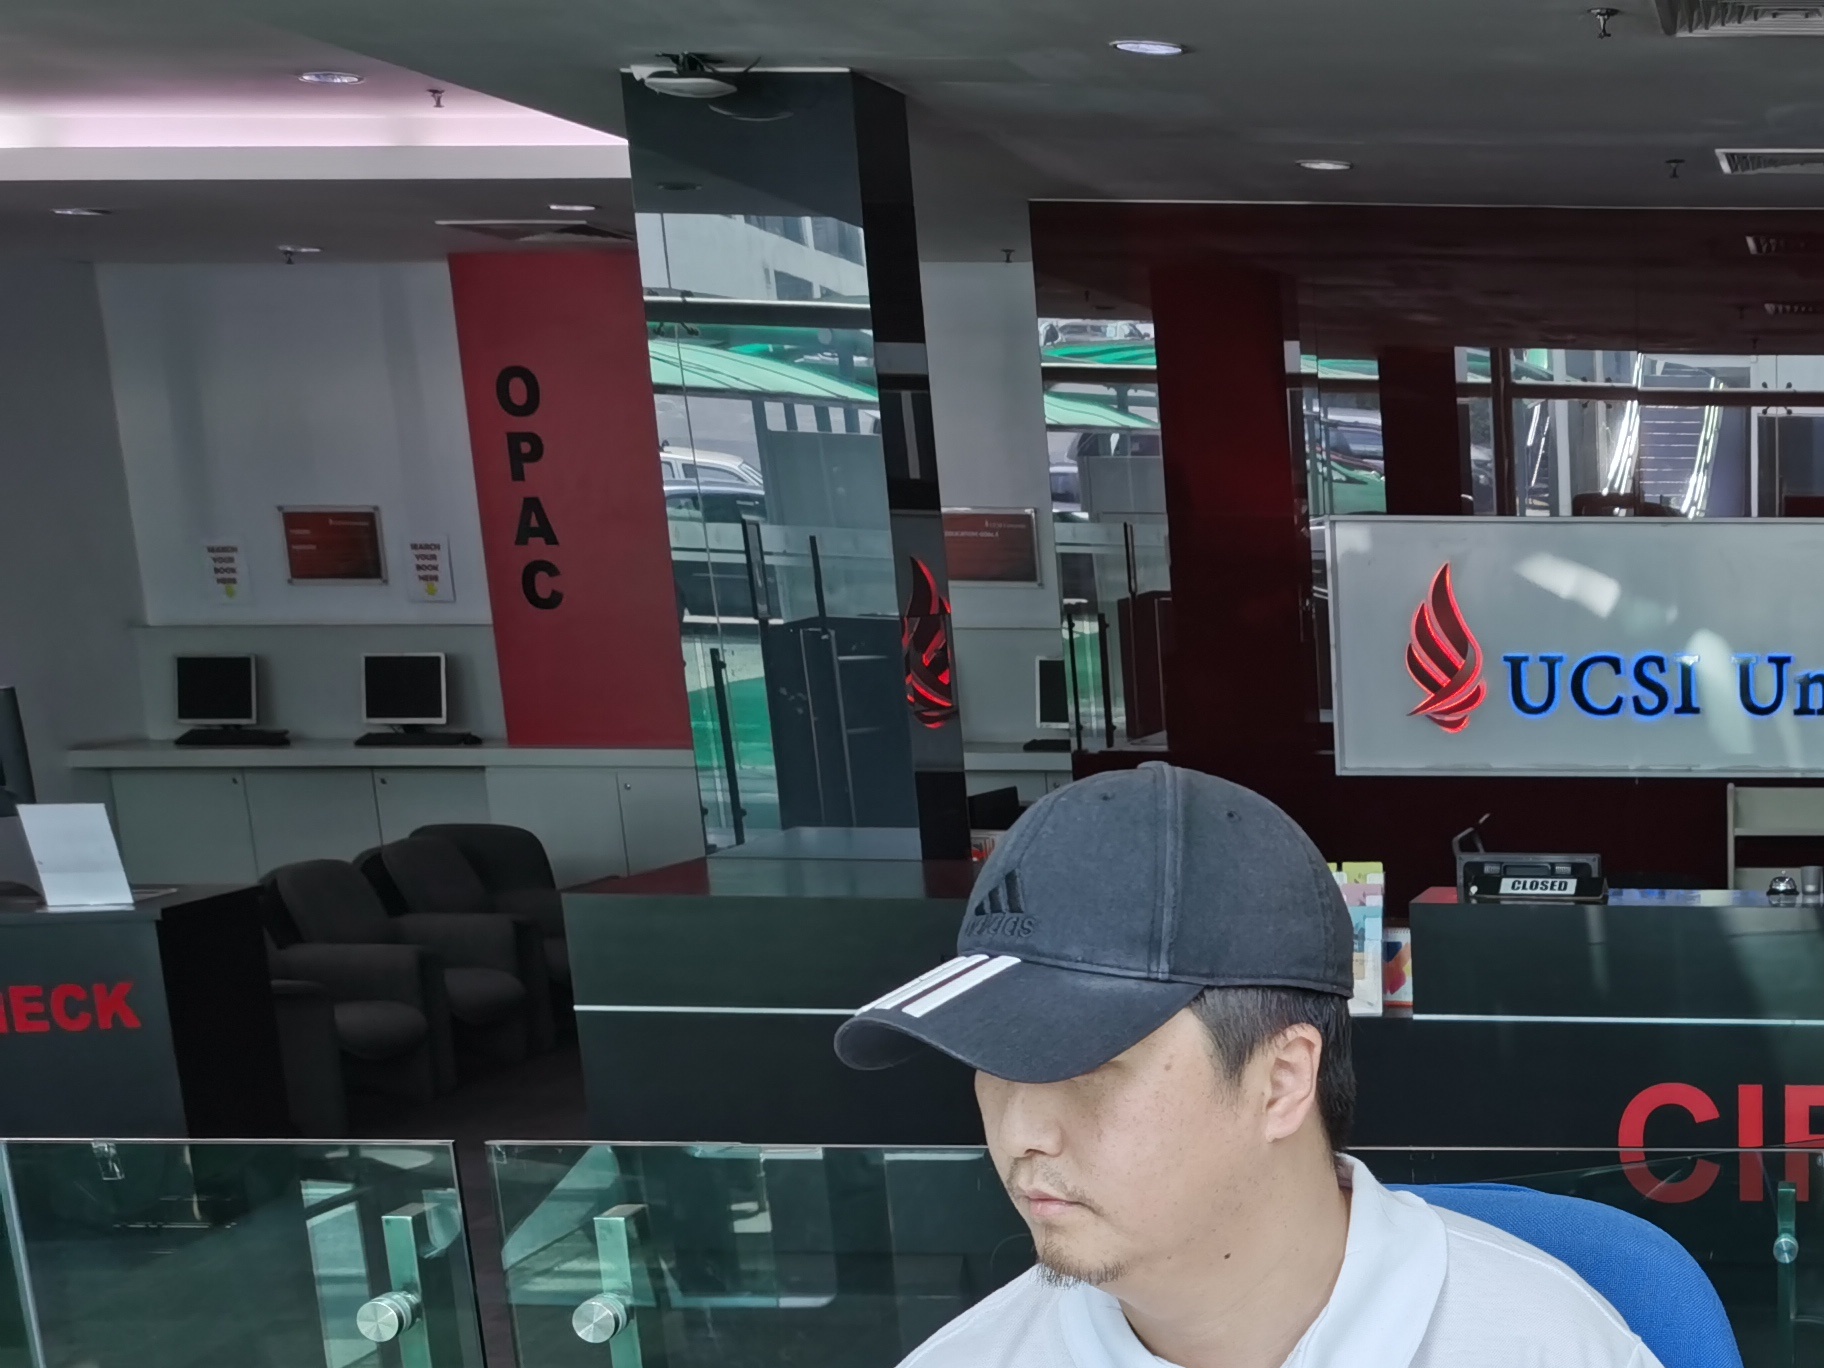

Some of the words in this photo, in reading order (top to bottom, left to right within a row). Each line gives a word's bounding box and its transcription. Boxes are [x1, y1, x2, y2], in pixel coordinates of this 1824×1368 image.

[495, 365, 564, 610] OPAC
[1503, 652, 1702, 720] UCSI
[1510, 879, 1570, 893] CLOSED
